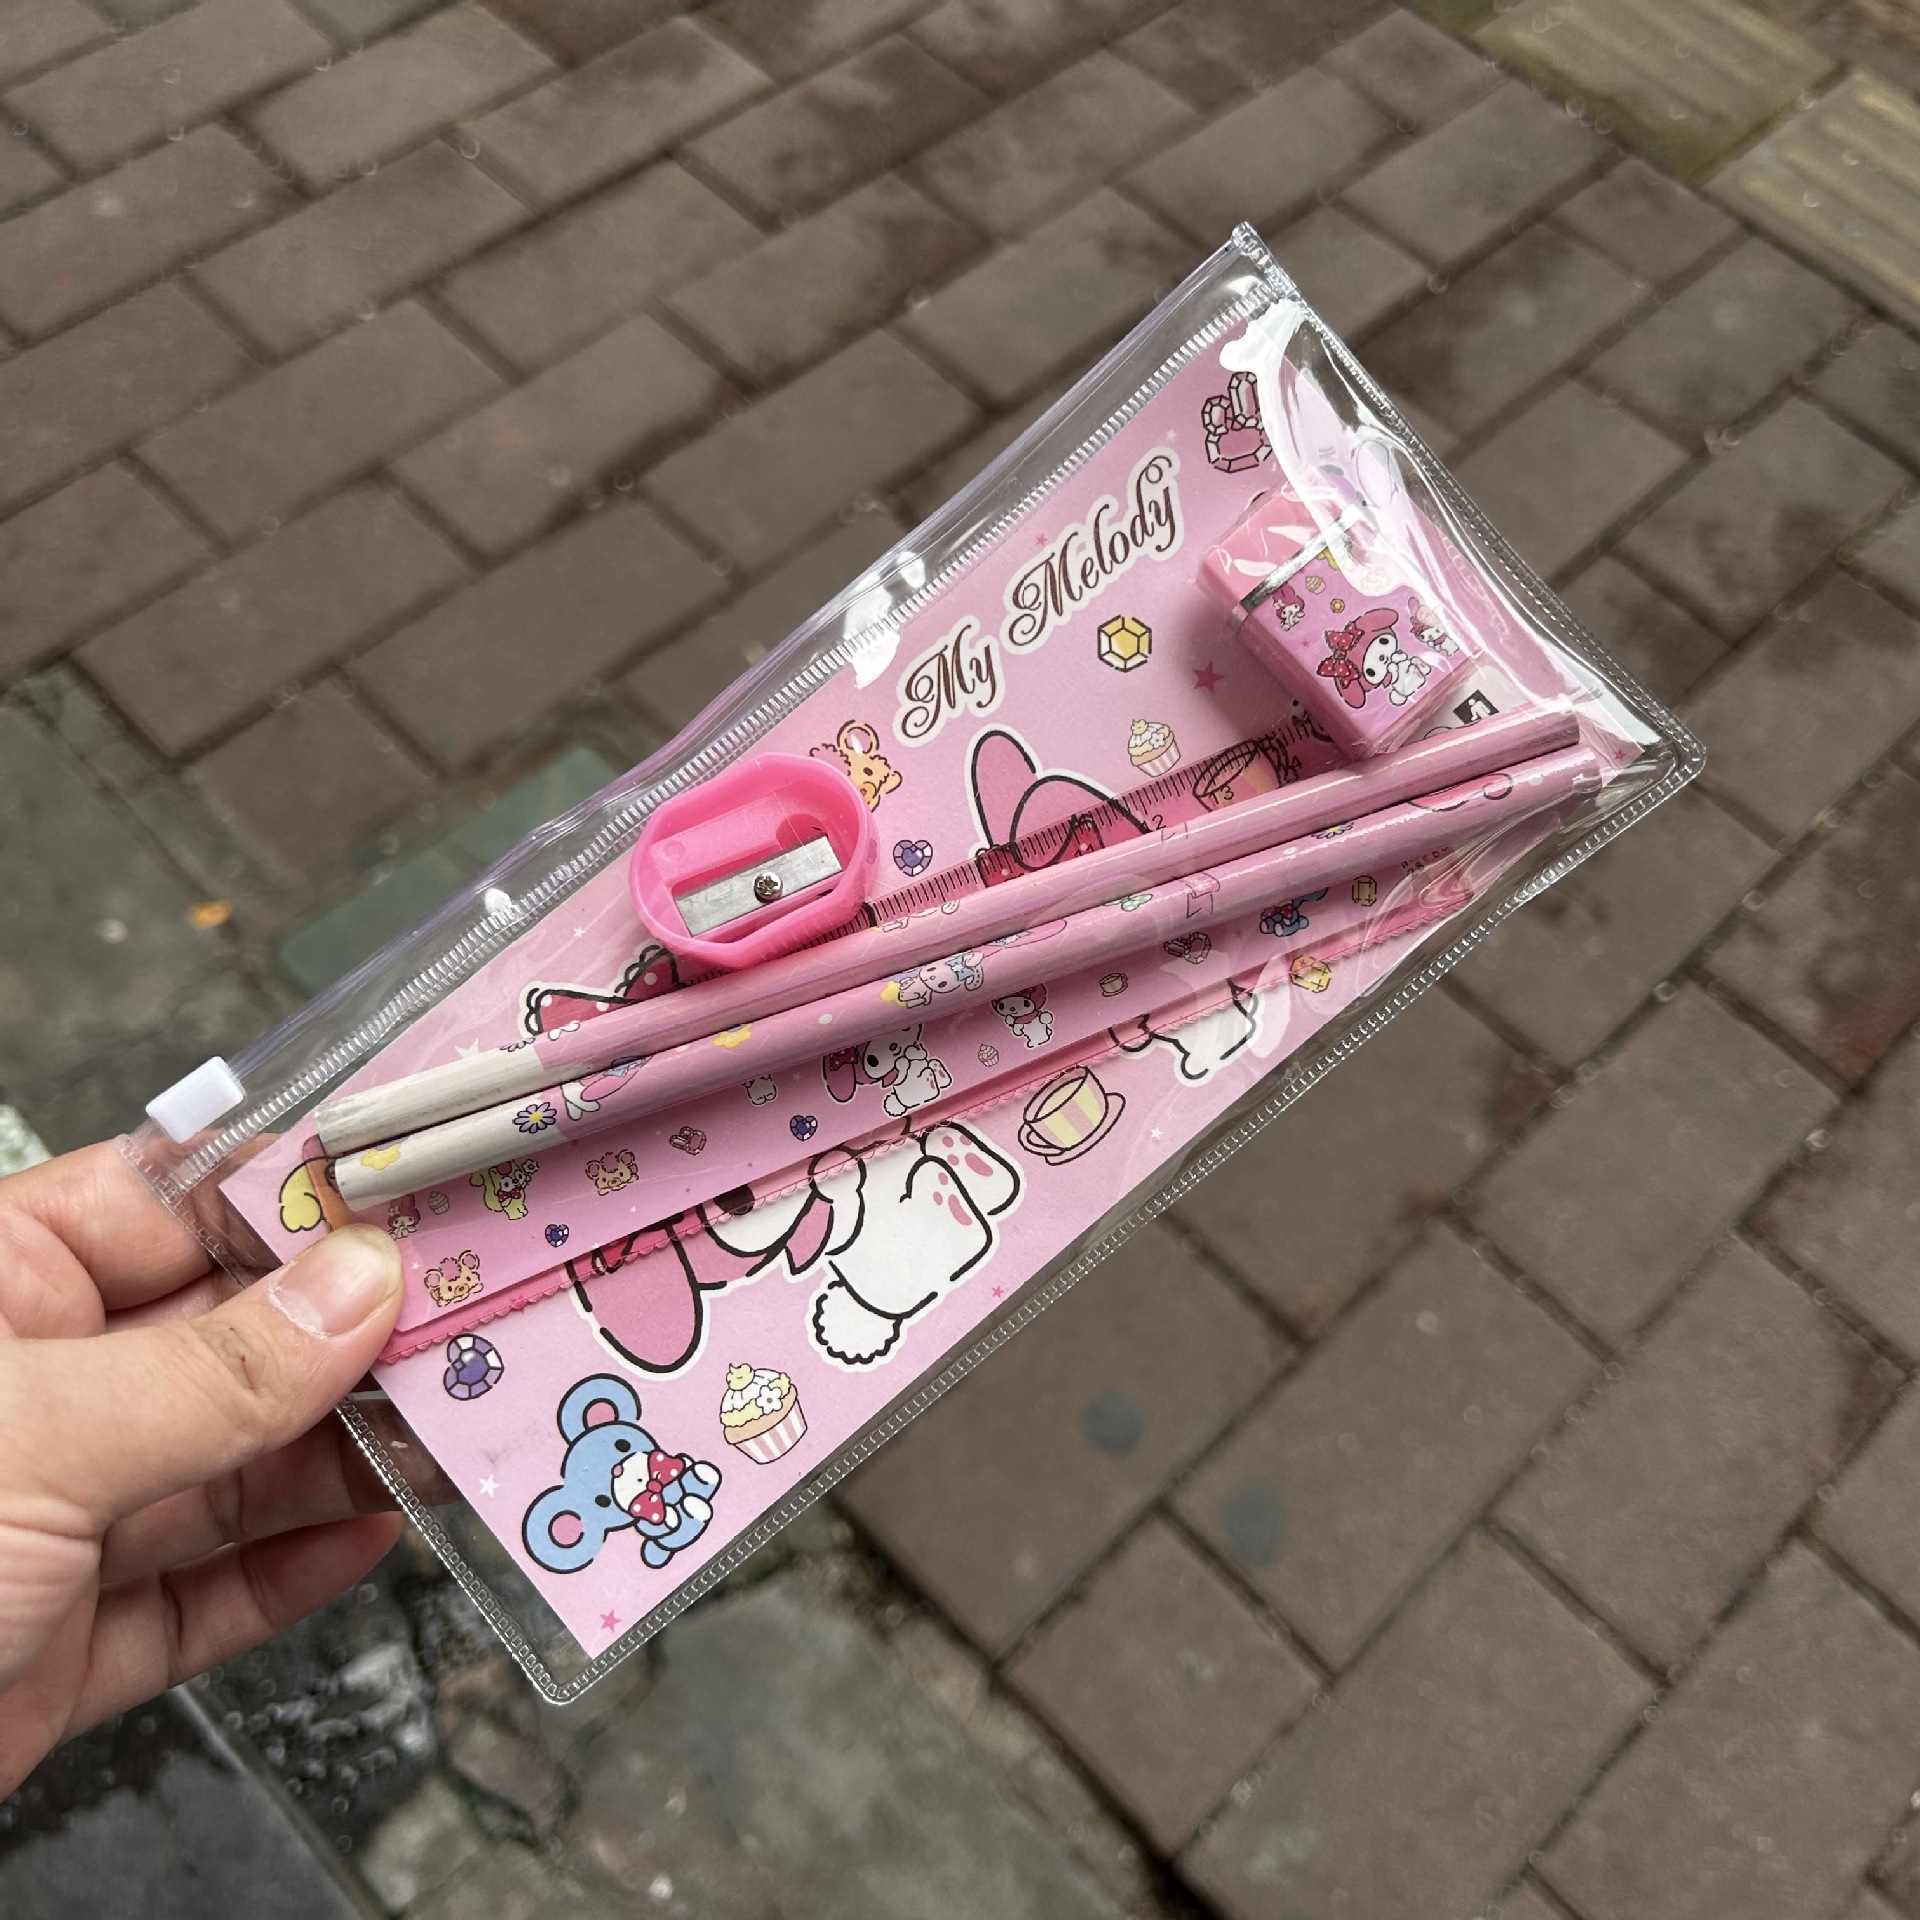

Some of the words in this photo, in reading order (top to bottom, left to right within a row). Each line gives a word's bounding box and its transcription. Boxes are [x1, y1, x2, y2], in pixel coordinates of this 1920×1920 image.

[901, 624, 997, 739] My
[1008, 455, 1176, 647] Melody
[1208, 784, 1235, 805] 13
